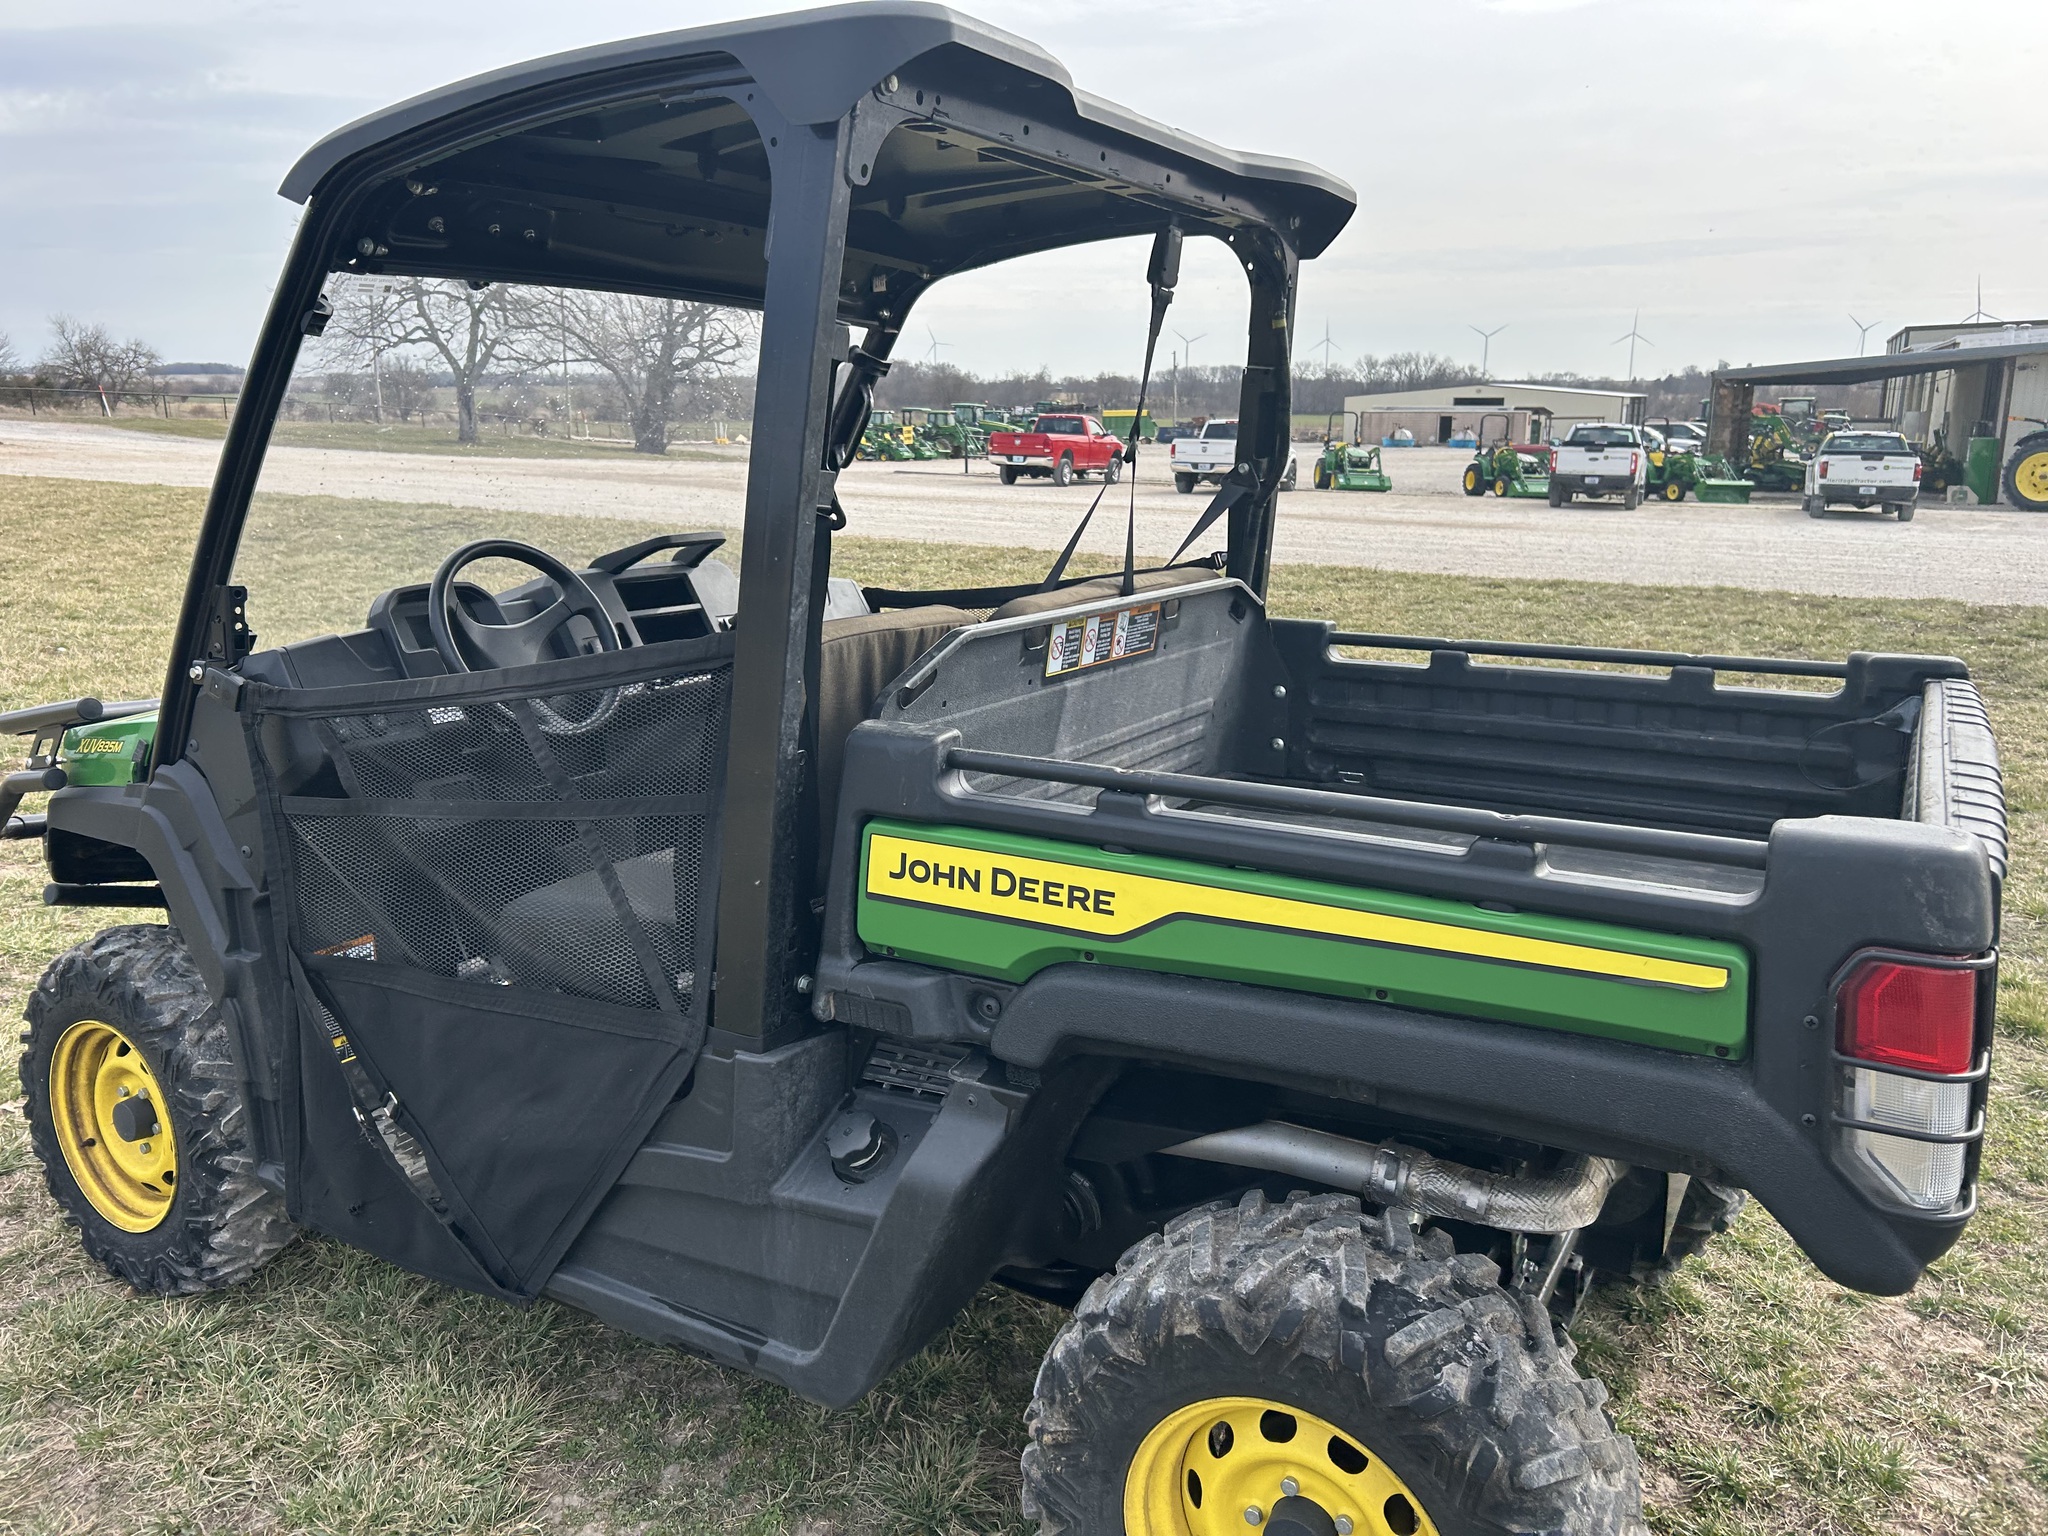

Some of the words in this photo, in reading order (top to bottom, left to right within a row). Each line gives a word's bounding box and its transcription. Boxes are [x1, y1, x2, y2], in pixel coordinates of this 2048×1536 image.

[1826, 477, 1893, 485] HeritageTractor.com
[75, 738, 124, 754] XUV835M
[889, 852, 981, 893] JOHN
[991, 867, 1116, 917] DEERE
